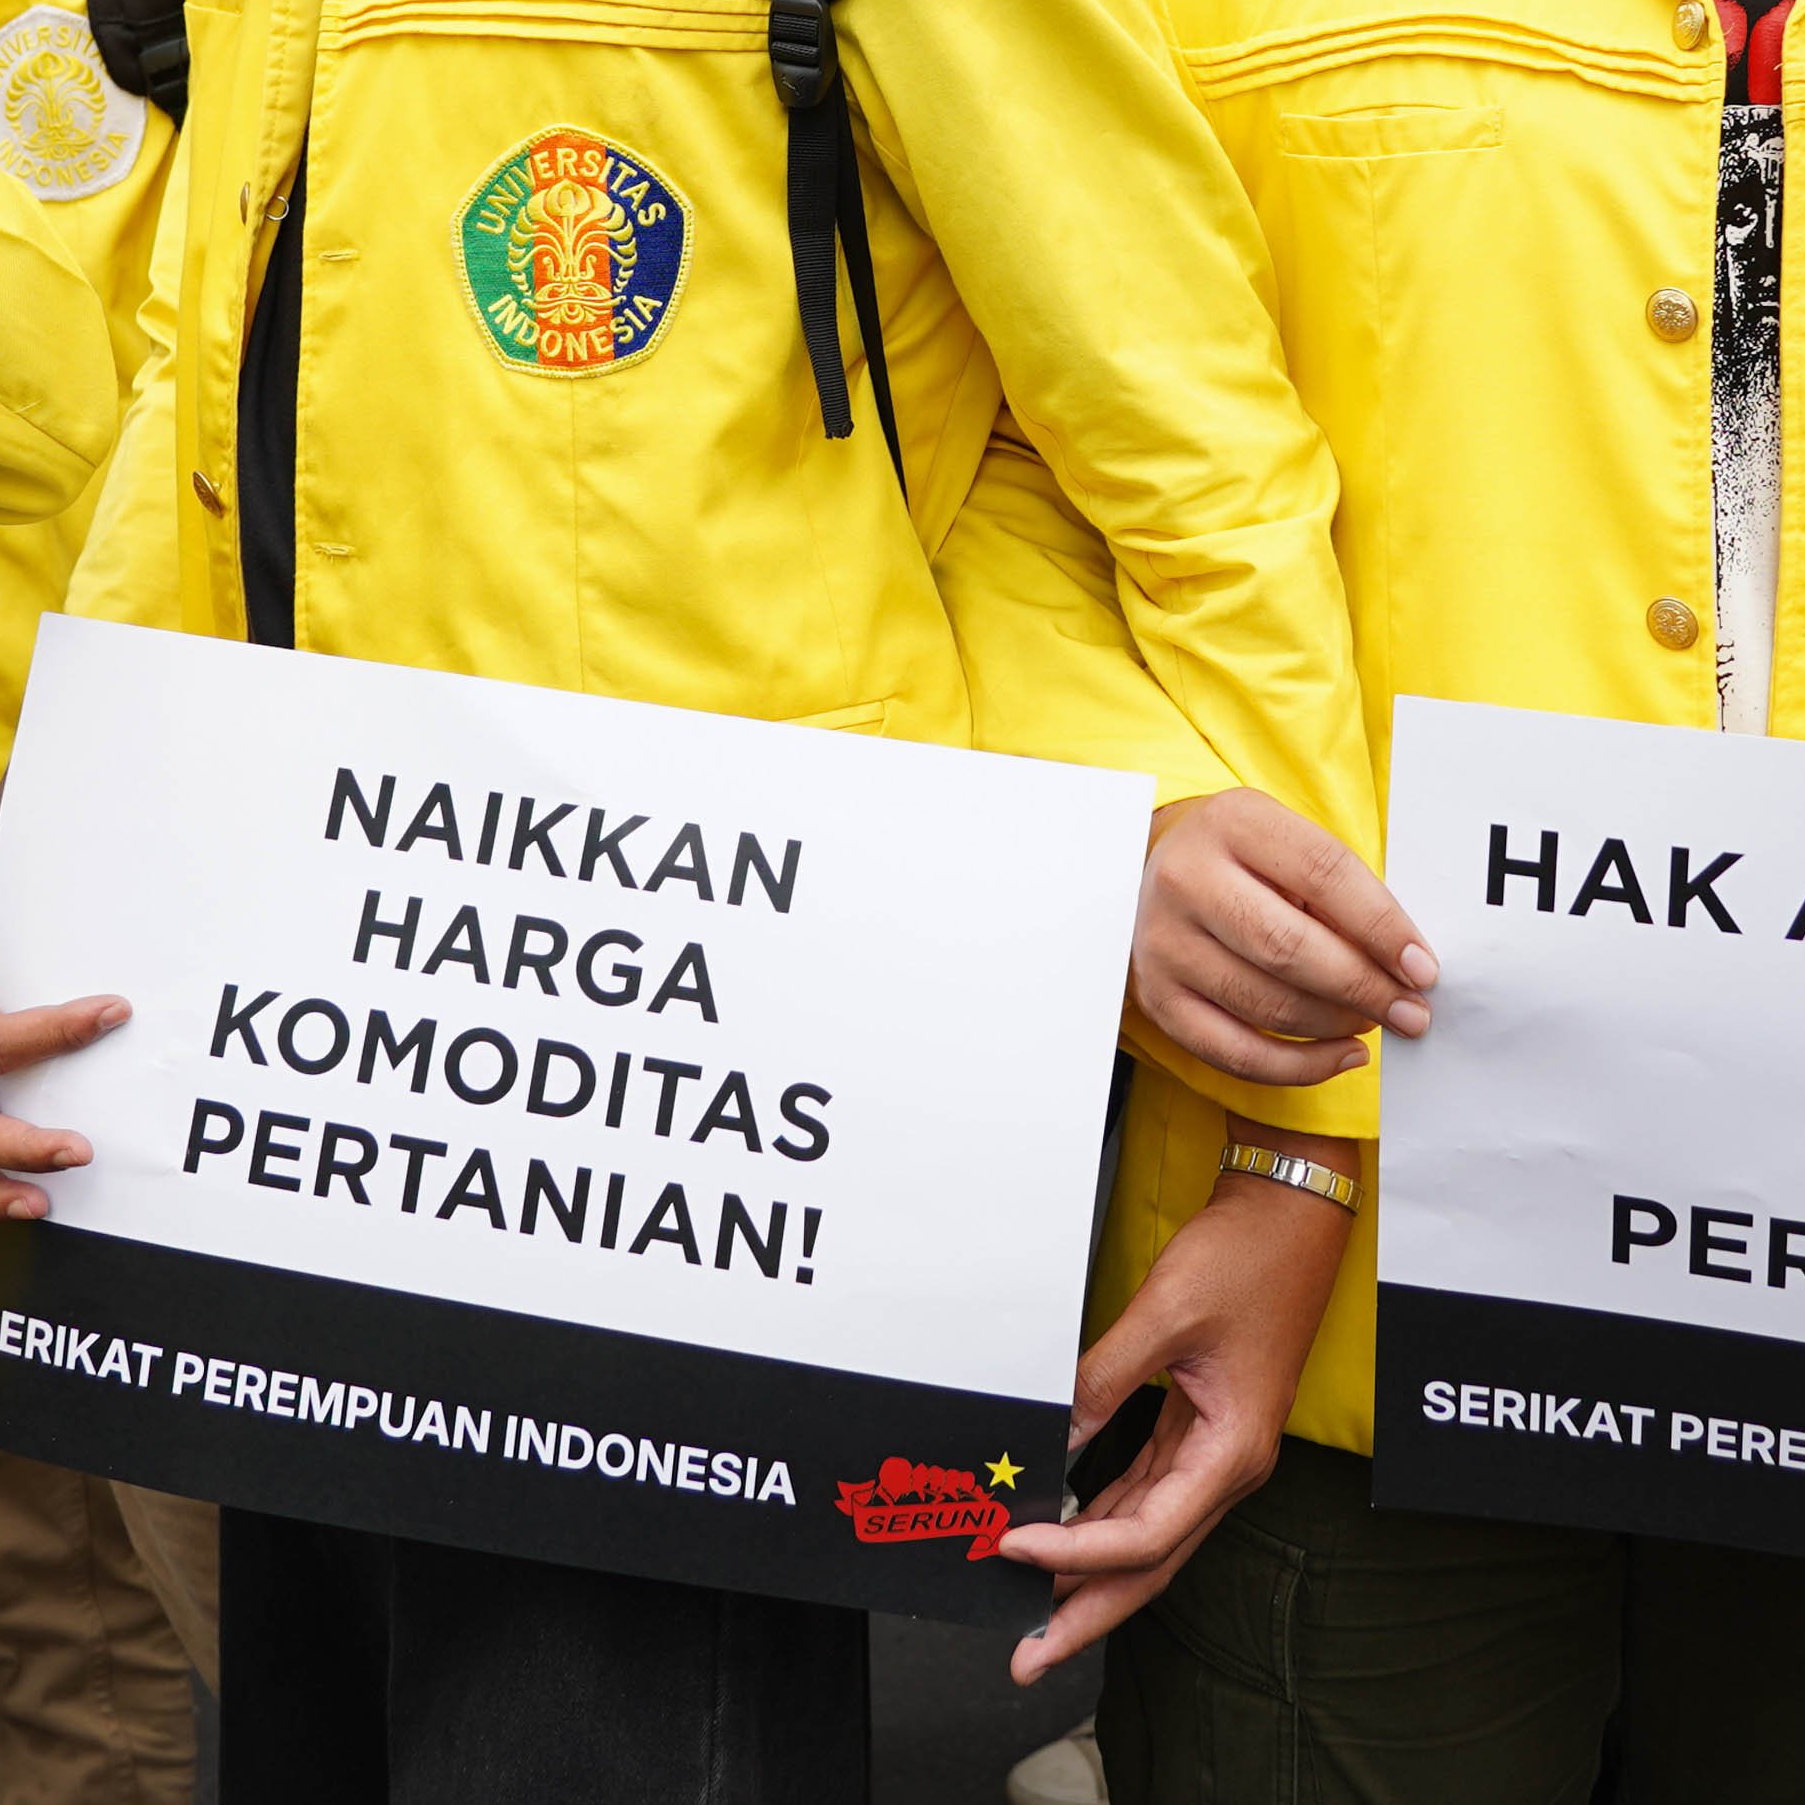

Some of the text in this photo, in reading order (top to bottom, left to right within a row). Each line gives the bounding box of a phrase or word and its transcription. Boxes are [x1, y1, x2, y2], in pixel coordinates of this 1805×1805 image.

[476, 146, 667, 236] UNIVERSITAS
[487, 293, 664, 362] INDONESIA
[325, 768, 801, 913] NAIKKAN
[1487, 825, 1743, 934] HAK
[353, 890, 718, 1023] HARGA
[210, 984, 831, 1161] KOMODITAS
[183, 1099, 822, 1284] PERTANIAN!
[172, 1352, 491, 1453] PEREMPUAN
[504, 1416, 795, 1505] INDONESIA
[1423, 1381, 1654, 1444] SERIKAT
[863, 1508, 996, 1535] SERUNI
